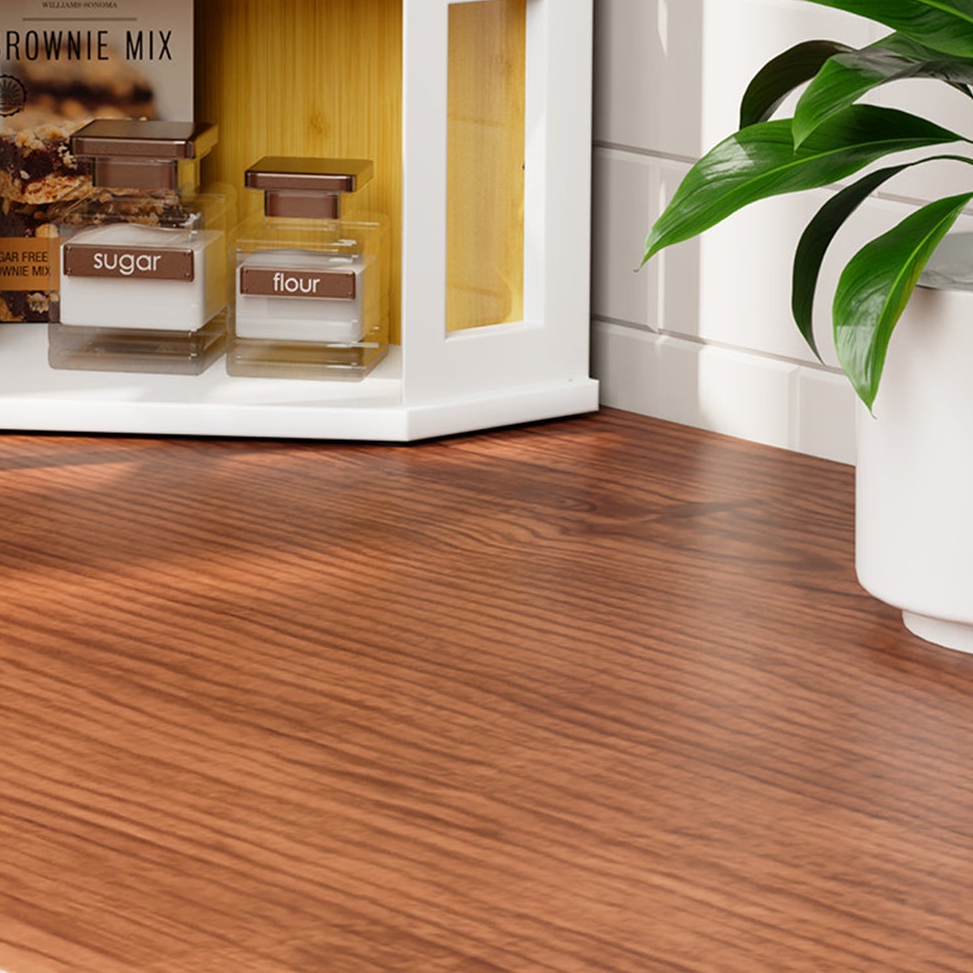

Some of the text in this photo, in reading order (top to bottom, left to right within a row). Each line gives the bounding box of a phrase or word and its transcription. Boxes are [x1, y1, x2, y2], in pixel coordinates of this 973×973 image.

[42, 1, 118, 9] WILLIAMS-SONOMA
[126, 30, 172, 61] MIX
[21, 251, 49, 263] FREE
[93, 252, 162, 276] sugar
[31, 265, 51, 277] MIX
[273, 272, 321, 294] flour
